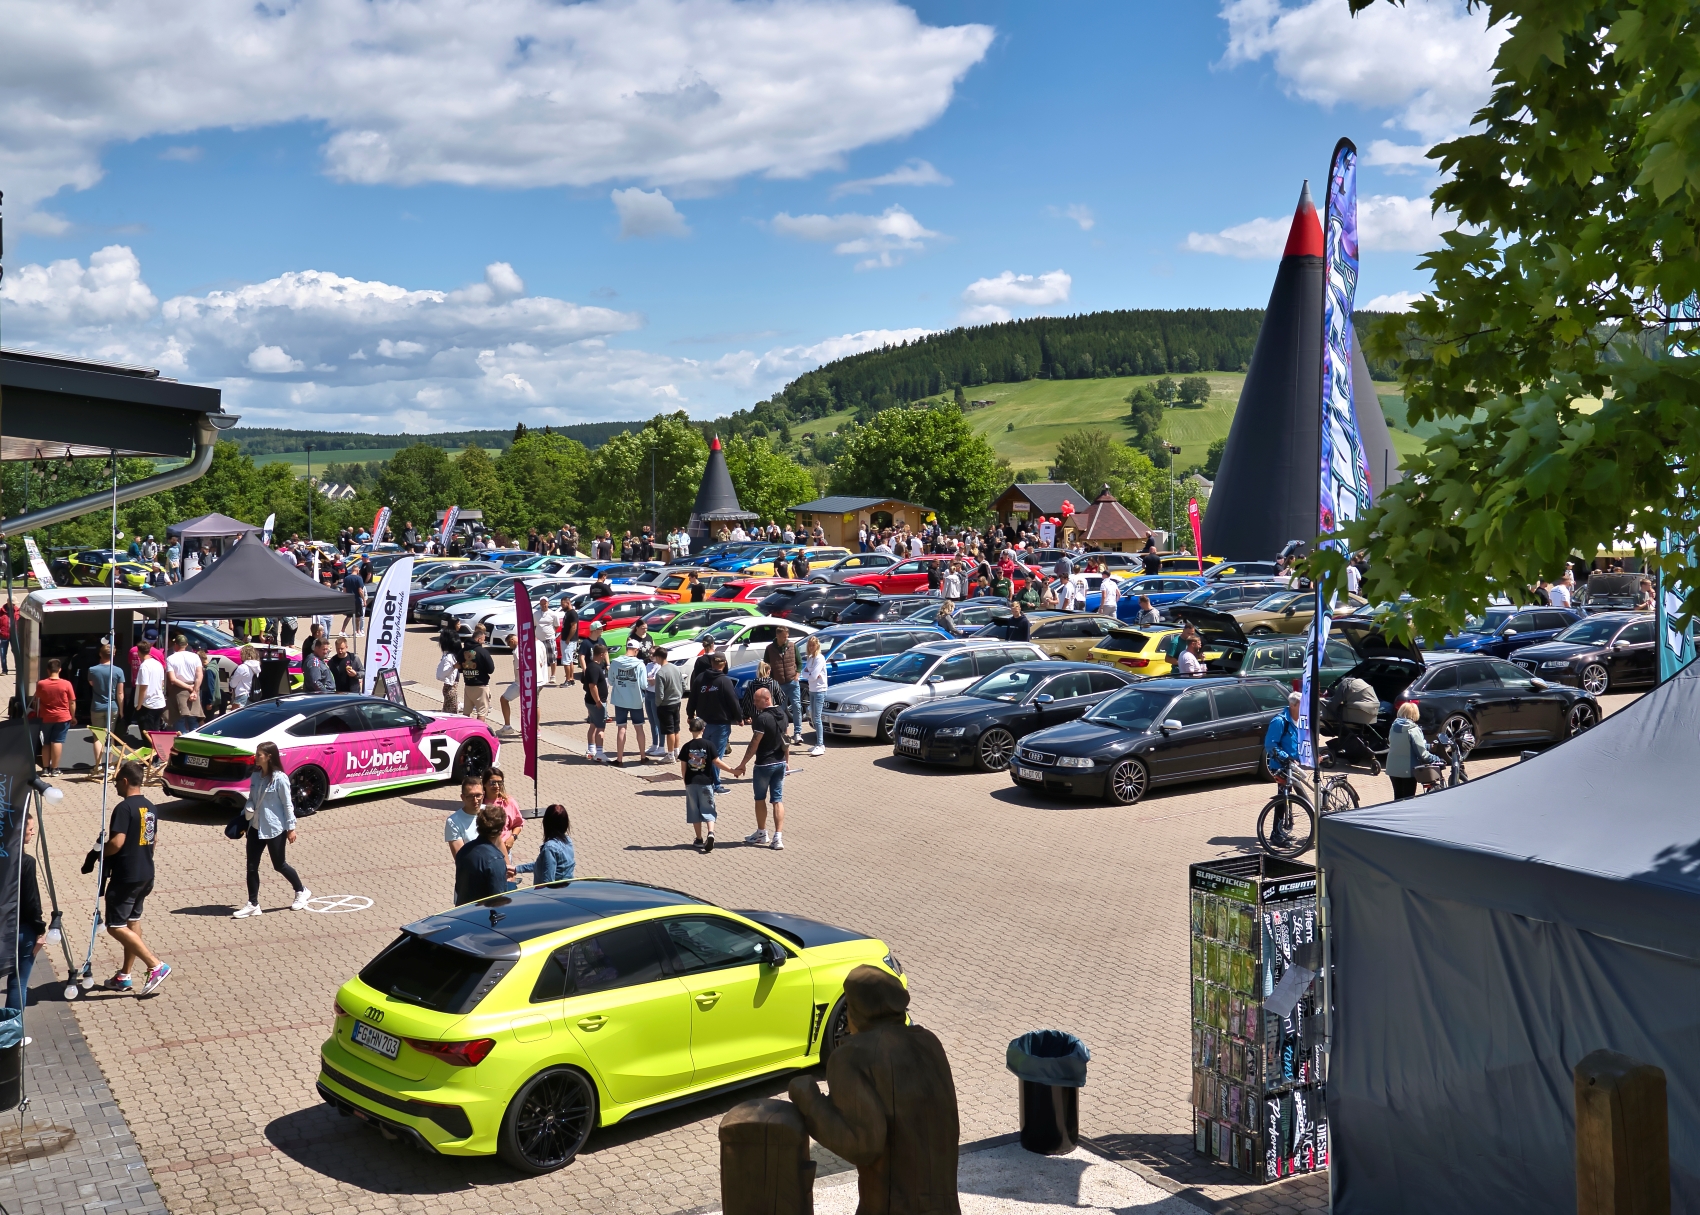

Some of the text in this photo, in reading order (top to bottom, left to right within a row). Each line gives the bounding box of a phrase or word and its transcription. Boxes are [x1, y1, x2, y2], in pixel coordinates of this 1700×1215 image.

[374, 589, 397, 681] übner
[346, 749, 410, 770] hübner
[430, 738, 451, 772] 5
[1196, 870, 1250, 889] SLAPSTICKER
[356, 1024, 369, 1042] FG
[371, 1030, 383, 1048] HN
[382, 1036, 398, 1054] 703
[1267, 1097, 1281, 1178] Performed
